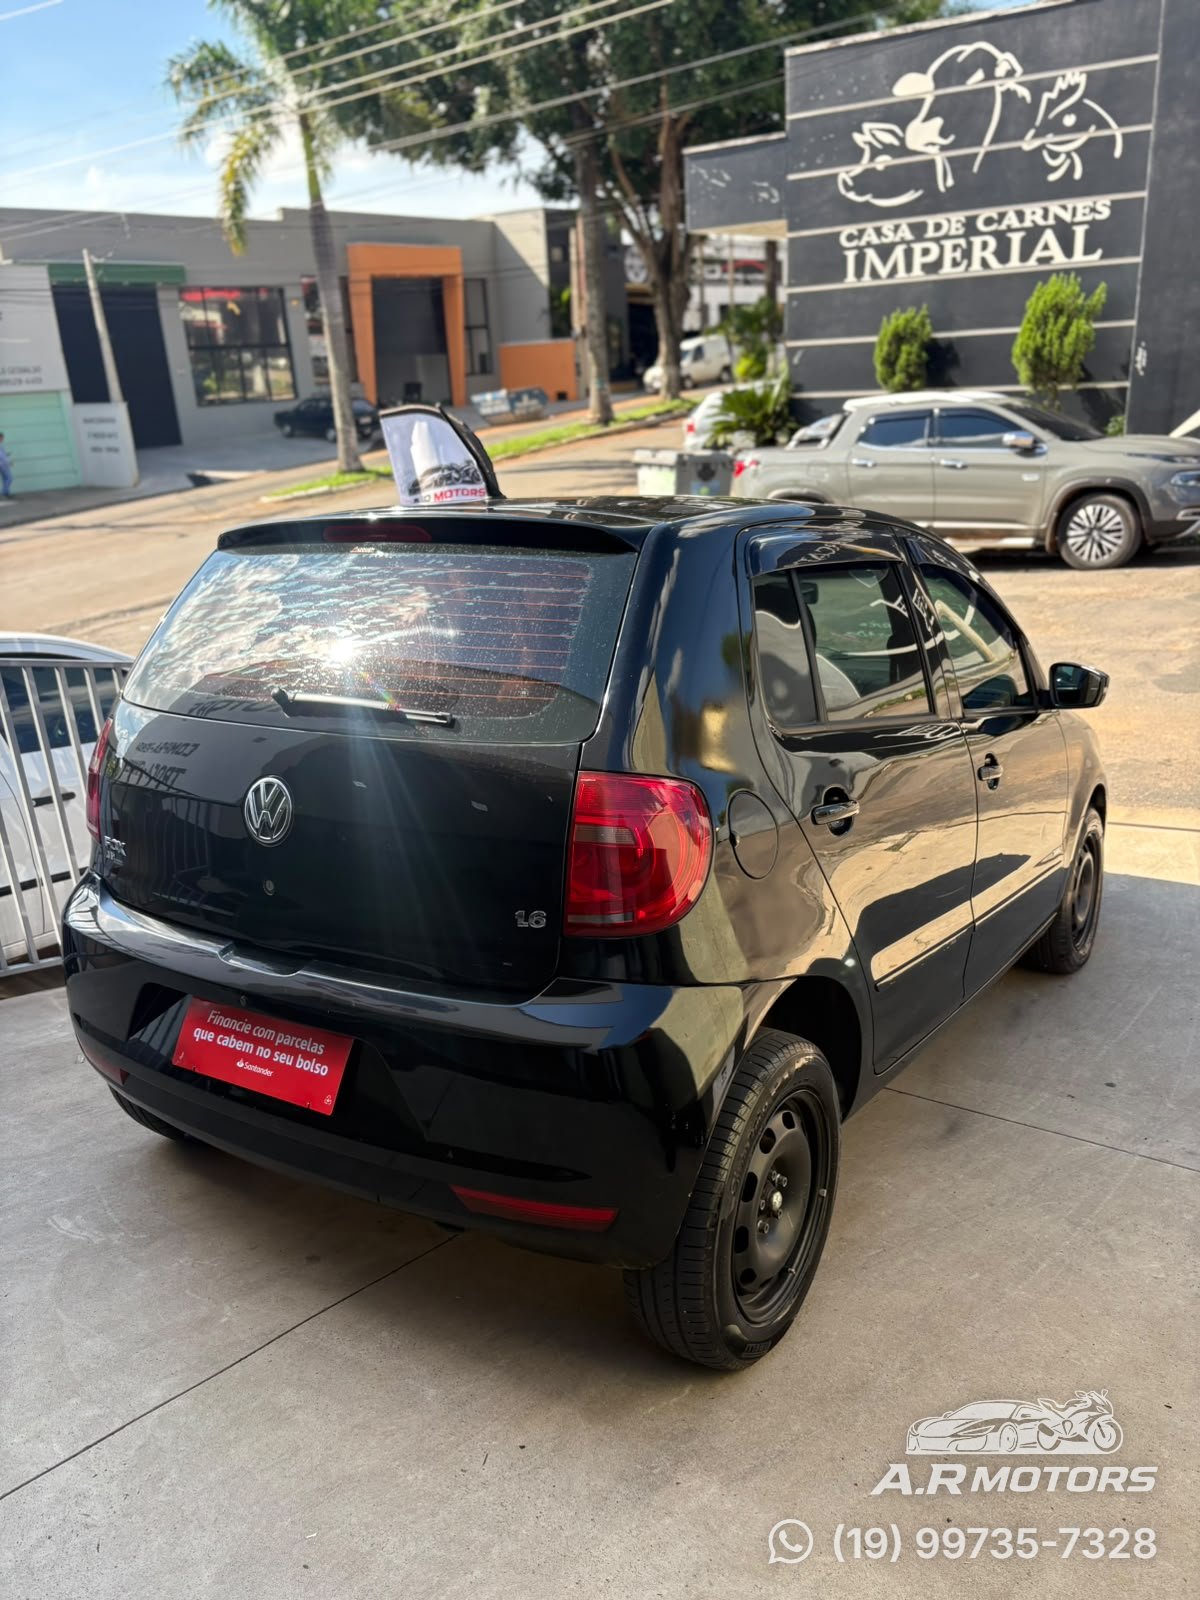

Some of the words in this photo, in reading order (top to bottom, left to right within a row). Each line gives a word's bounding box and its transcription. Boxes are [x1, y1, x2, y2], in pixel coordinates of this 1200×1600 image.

[839, 222, 914, 247] CASA
[925, 215, 967, 238] DE
[976, 199, 1111, 232] CARNES
[843, 223, 1103, 283] IMPERIAL
[433, 487, 486, 503] MOTORS
[193, 1027, 214, 1042] que
[216, 1033, 255, 1054] cabem
[256, 1045, 271, 1059] no
[273, 1050, 294, 1066] seu
[295, 1054, 329, 1077] bolso
[207, 1009, 252, 1034] Financie
[252, 1024, 276, 1041] com
[275, 1031, 325, 1056] parcelas
[243, 1061, 274, 1078] Santander
